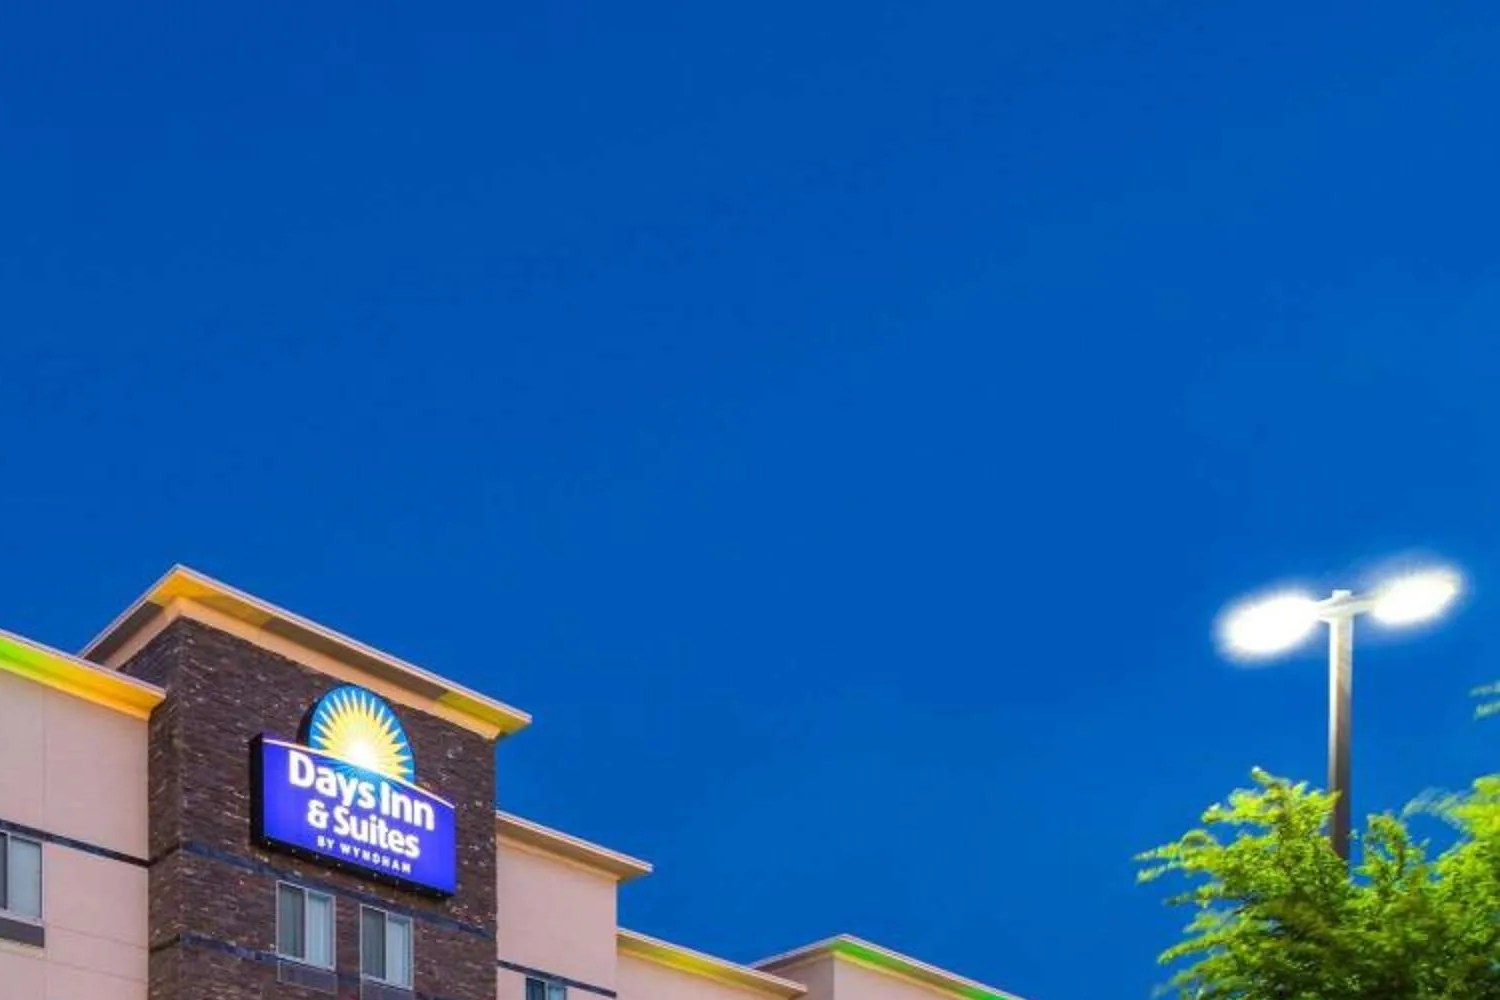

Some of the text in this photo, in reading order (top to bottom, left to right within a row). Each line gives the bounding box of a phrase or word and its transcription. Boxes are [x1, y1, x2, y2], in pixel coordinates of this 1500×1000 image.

[288, 750, 435, 831] Days Inn
[307, 799, 420, 859] & Suites
[317, 835, 411, 874] BY WYNDHAM
